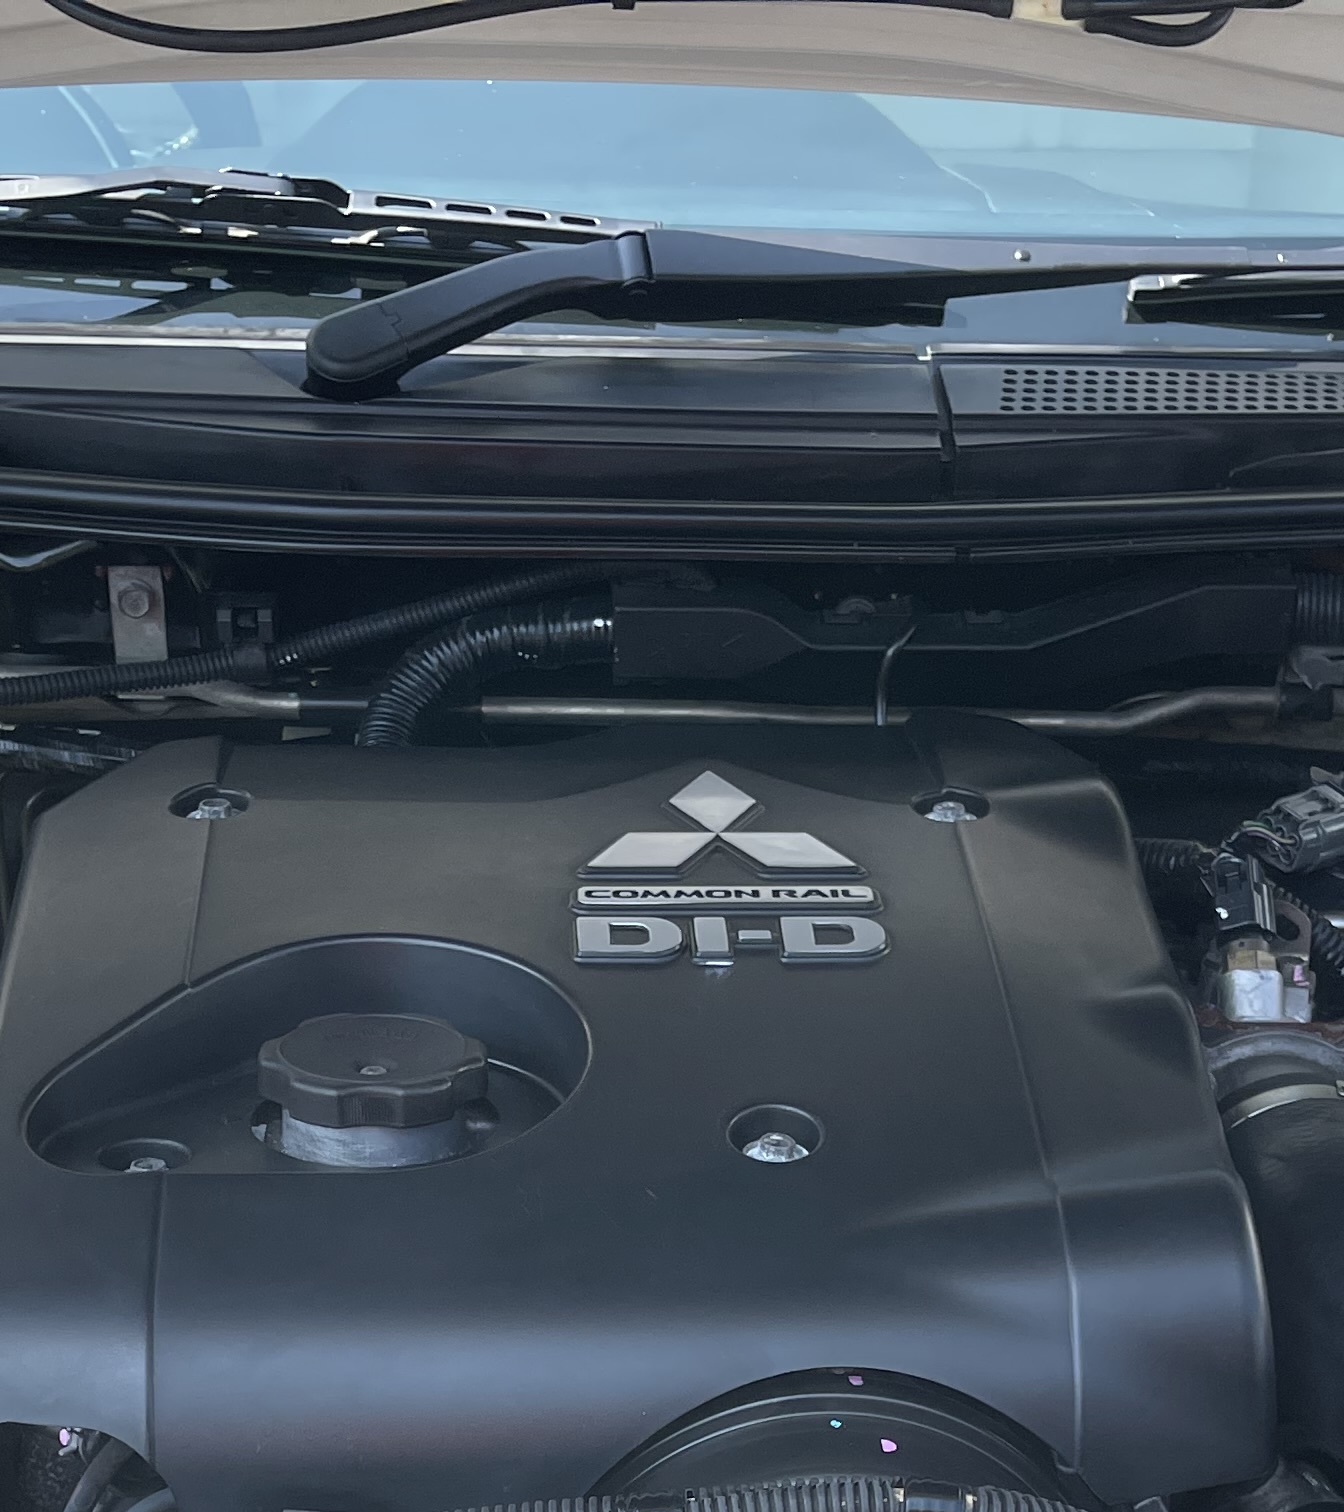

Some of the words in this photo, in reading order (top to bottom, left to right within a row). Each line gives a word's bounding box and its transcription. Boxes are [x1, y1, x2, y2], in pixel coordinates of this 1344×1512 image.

[584, 888, 761, 900] COMMON
[771, 888, 868, 900] RAIL
[574, 915, 891, 965] DI-D
